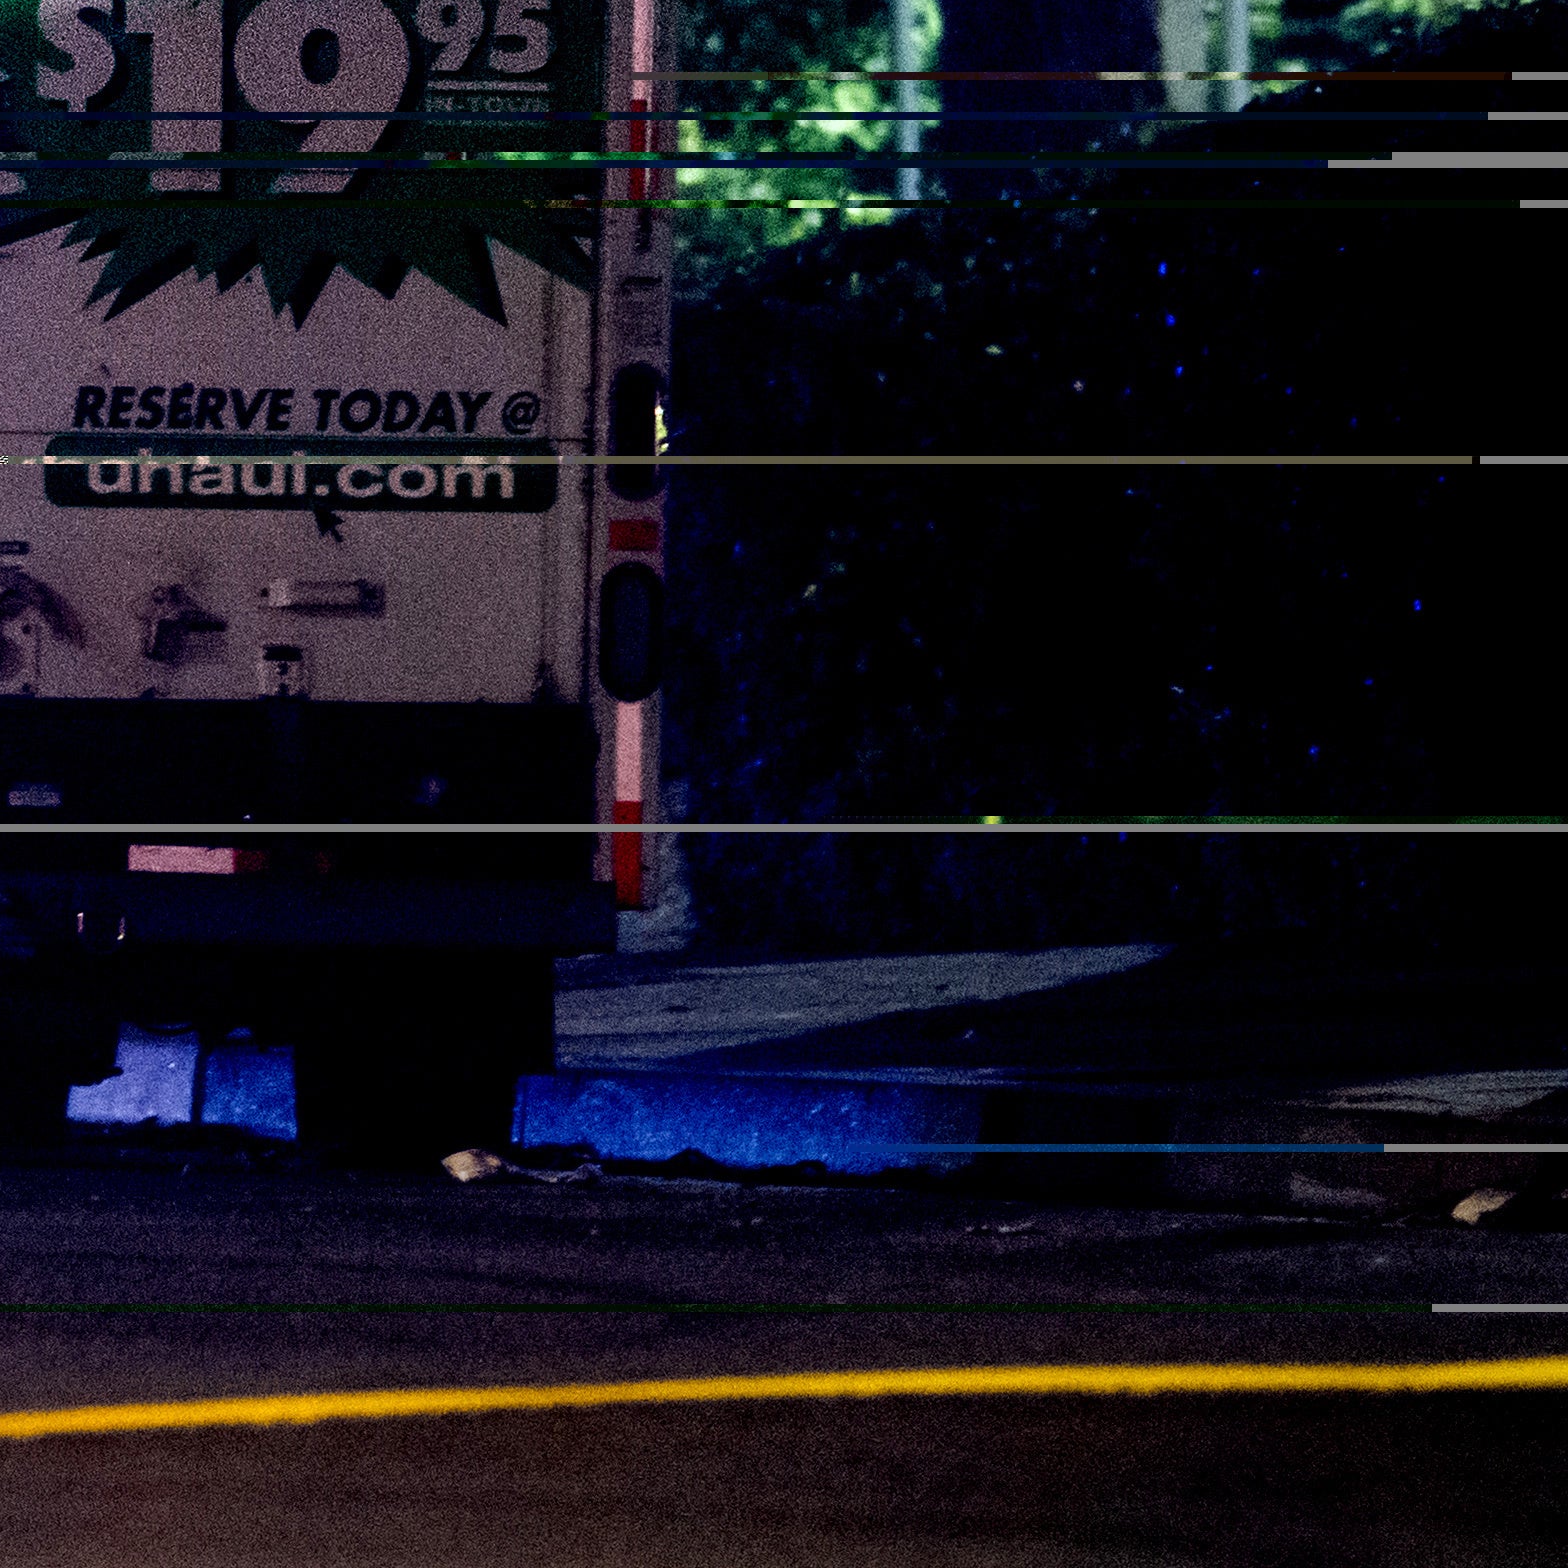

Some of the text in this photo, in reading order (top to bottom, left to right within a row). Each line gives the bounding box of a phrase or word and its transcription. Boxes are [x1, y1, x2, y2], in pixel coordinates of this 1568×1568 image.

[73, 385, 541, 434] RESERVE TODAY @
[87, 447, 516, 499] uhaul.com
